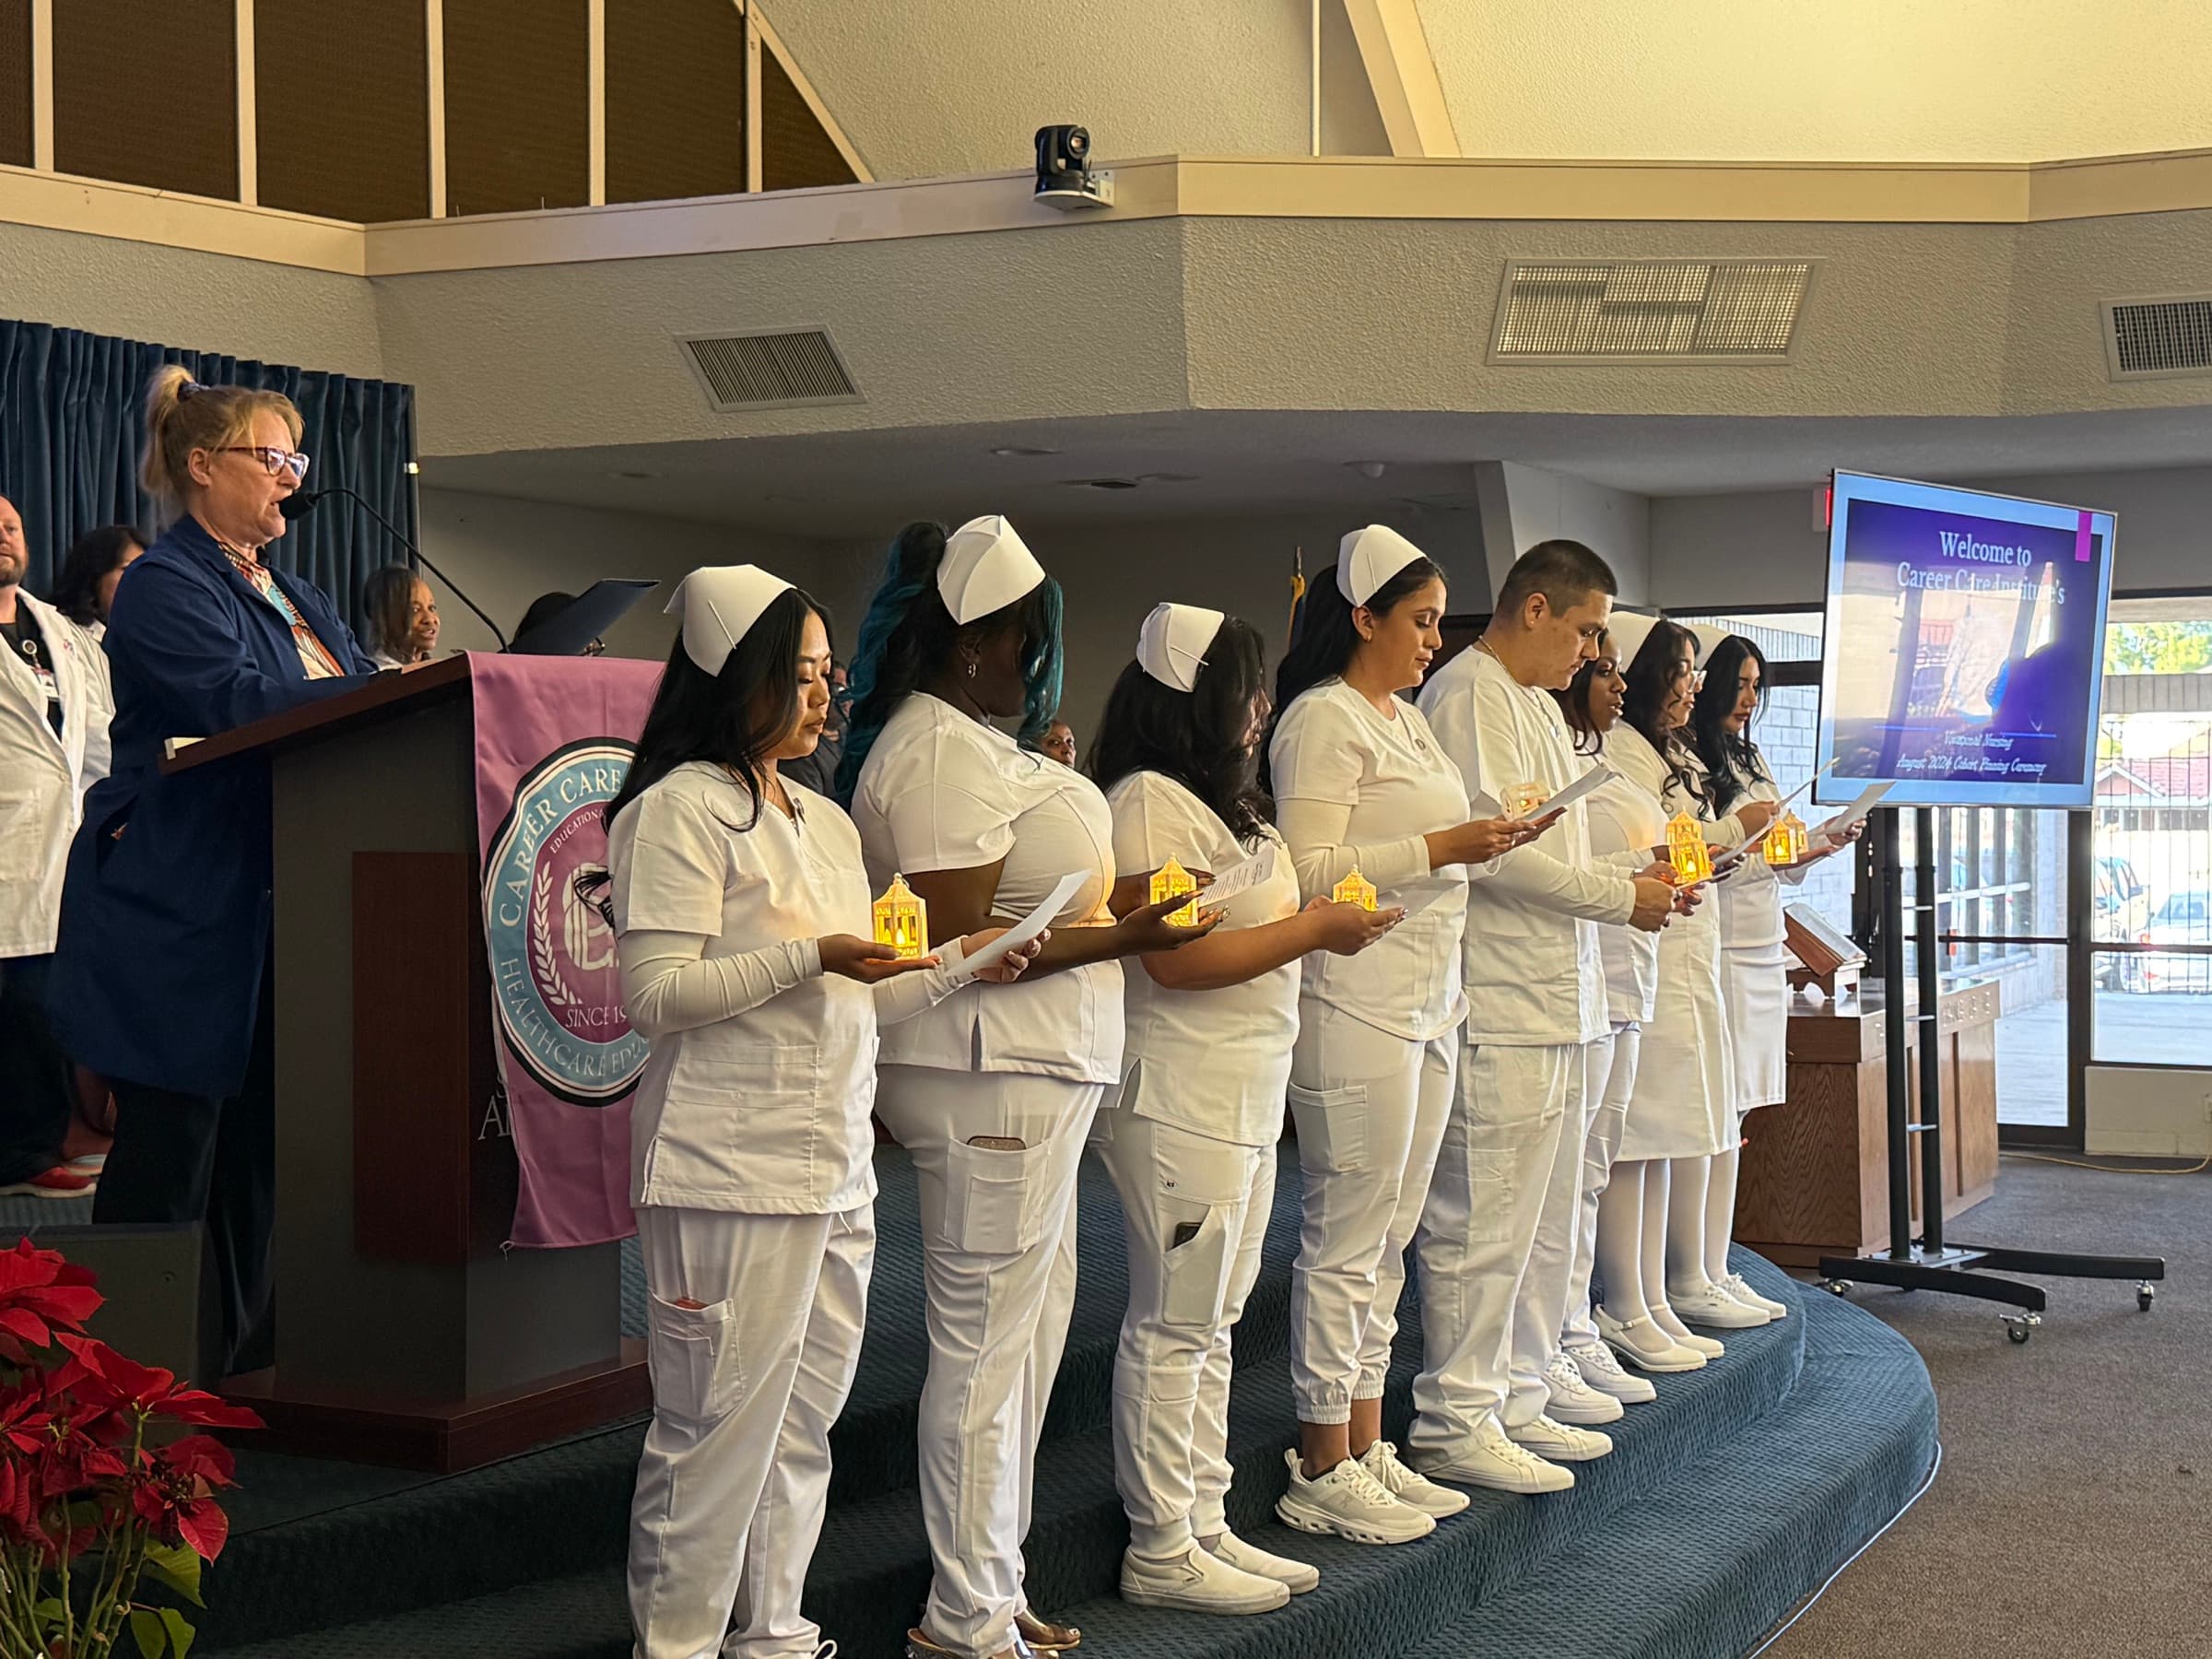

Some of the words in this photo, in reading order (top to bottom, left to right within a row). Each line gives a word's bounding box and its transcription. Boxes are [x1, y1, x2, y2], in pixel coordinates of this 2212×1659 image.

[1939, 531, 2014, 565] Welcome
[2017, 545, 2032, 567] to
[1897, 561, 1952, 591] Career
[1955, 569, 1993, 592] Care
[1995, 572, 2065, 605] Institue's
[500, 798, 559, 927] CAREER
[559, 768, 622, 805] CARE
